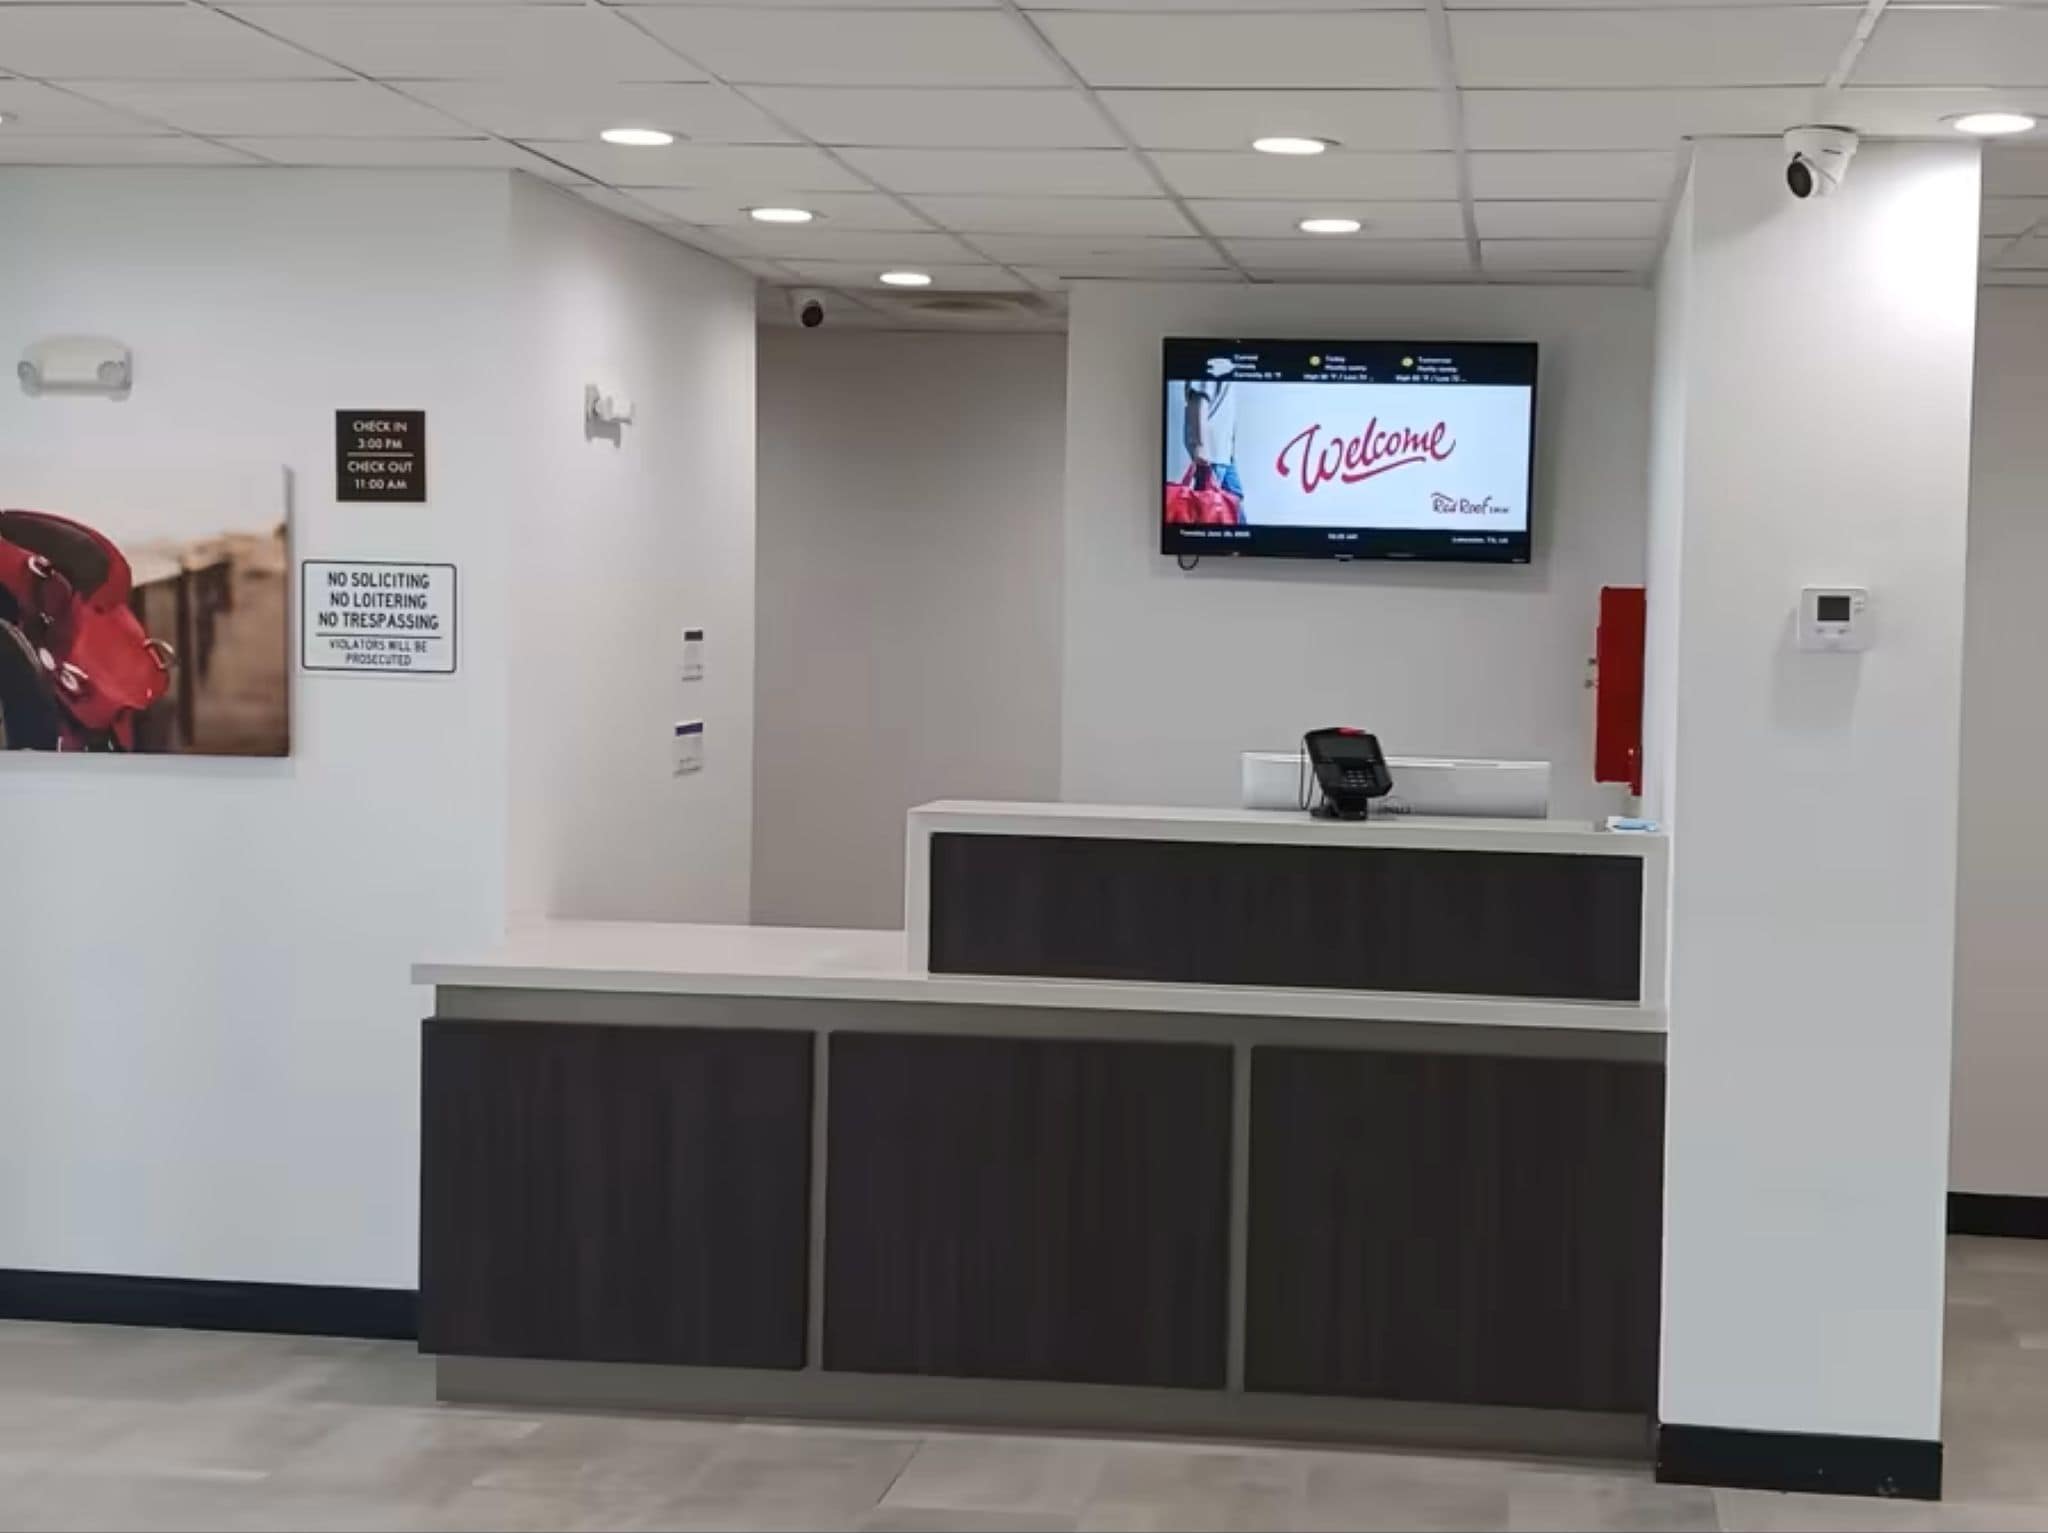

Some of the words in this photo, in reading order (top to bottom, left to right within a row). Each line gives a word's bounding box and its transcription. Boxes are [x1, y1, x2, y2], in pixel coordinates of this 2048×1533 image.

[353, 420, 391, 433] CHECK
[393, 421, 408, 433] IN
[358, 438, 383, 449] 3:00
[385, 438, 403, 449] PM
[1276, 416, 1456, 494] Welcome
[347, 461, 385, 473] CHECK
[387, 461, 413, 473] OUT
[354, 479, 385, 490] 11:00
[386, 479, 408, 490] AM
[1430, 492, 1458, 514] Red
[1459, 495, 1493, 515] Roof
[328, 571, 348, 588] NO
[351, 572, 430, 589] SOLICITING
[330, 591, 350, 608] NO
[353, 592, 428, 610] LOITERING
[318, 611, 339, 628] NO
[342, 612, 440, 630] TRESPASSING
[329, 638, 385, 651] VIOLATORS
[388, 640, 412, 653] WILL
[414, 641, 428, 653] BE
[345, 653, 412, 666] PROSECUTED
